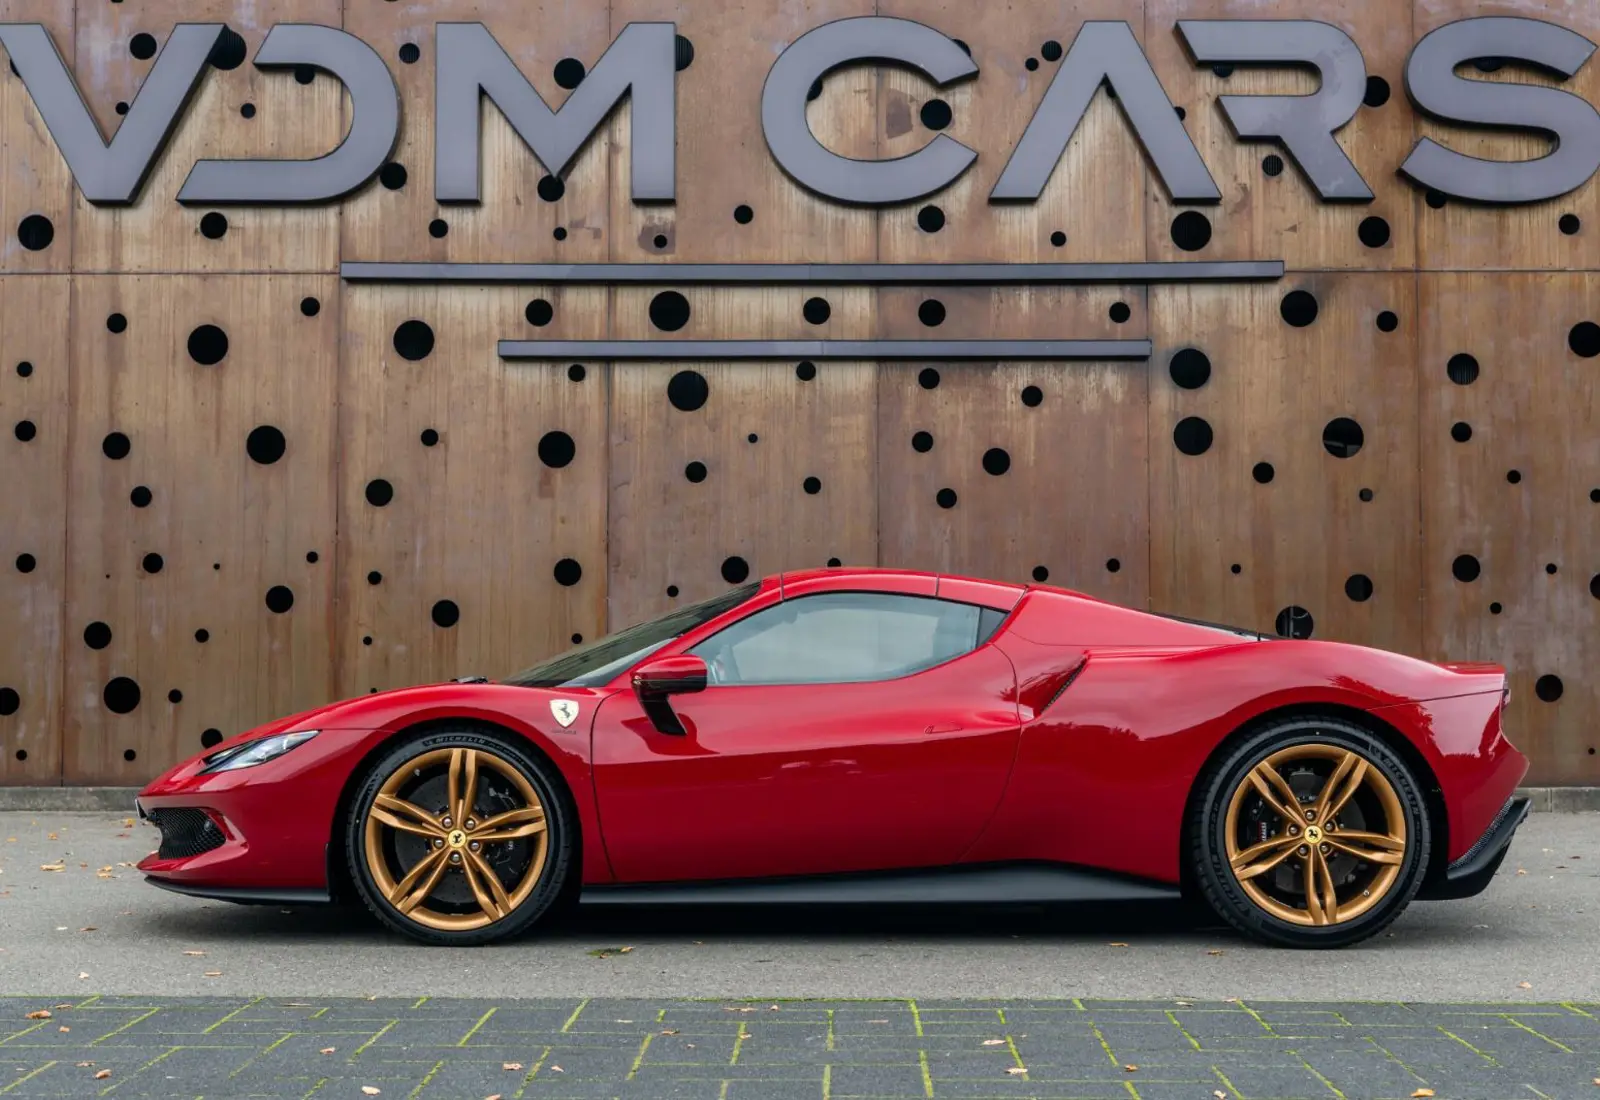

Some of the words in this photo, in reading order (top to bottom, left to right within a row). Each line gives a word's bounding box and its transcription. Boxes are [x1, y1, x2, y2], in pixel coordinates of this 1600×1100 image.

[0, 22, 677, 205] VDM
[761, 15, 1600, 206] CARS
[435, 735, 486, 745] MICHELIN
[1381, 758, 1420, 815] MICHELIN
